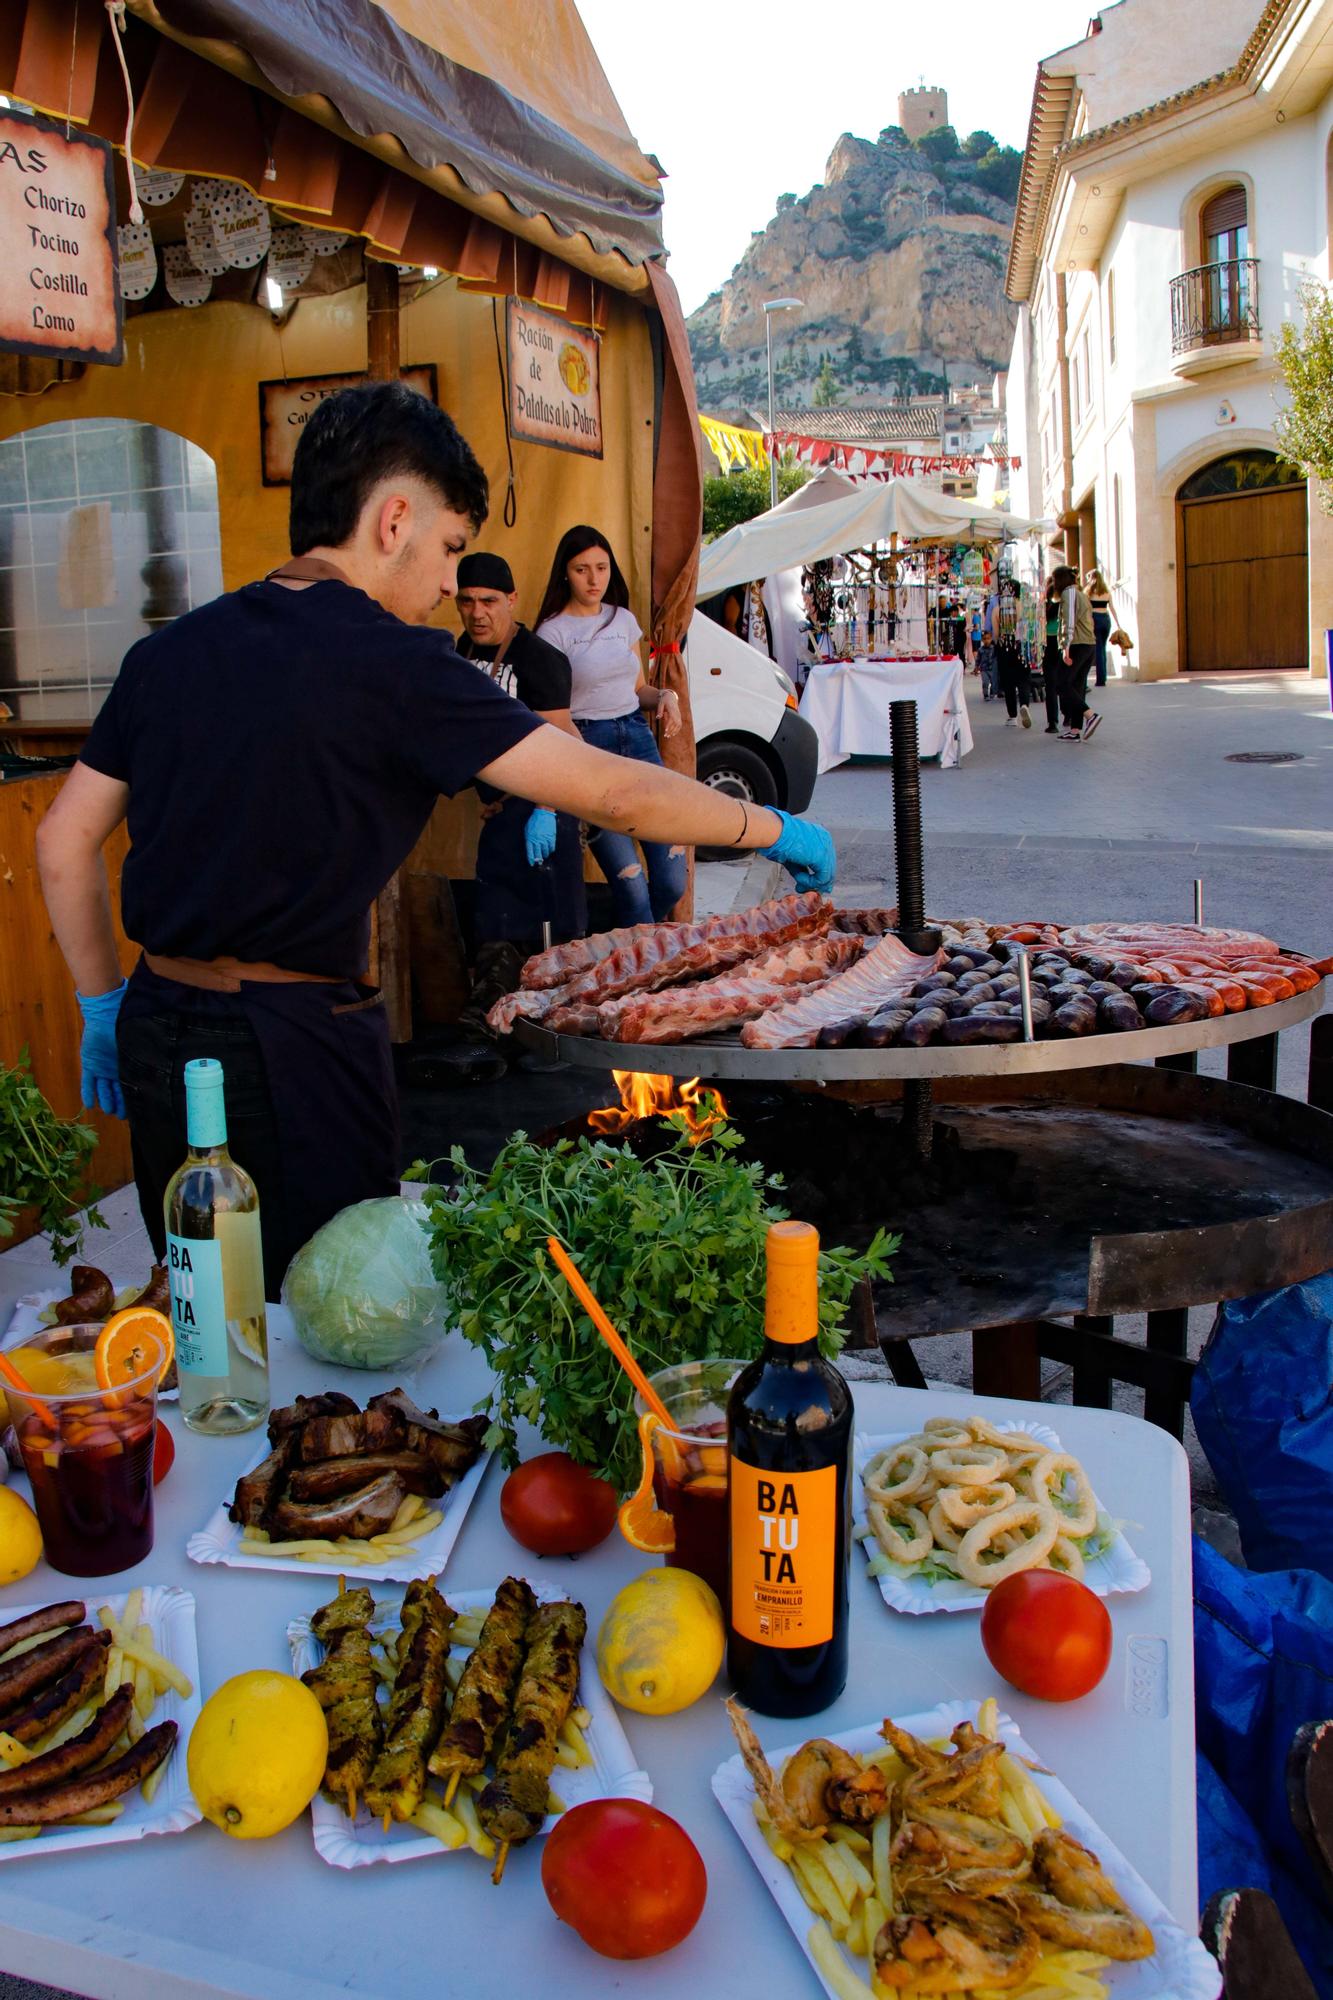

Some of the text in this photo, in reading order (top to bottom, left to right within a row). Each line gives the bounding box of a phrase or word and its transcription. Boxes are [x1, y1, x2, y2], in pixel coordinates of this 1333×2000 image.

[24, 186, 86, 219] Chorizo
[27, 224, 79, 256] Tocino
[30, 267, 88, 296] Costilla
[32, 305, 75, 332] Lomo
[516, 316, 553, 352] Ración
[530, 357, 542, 381] de
[516, 384, 597, 437] Patatas a lo Pobre
[170, 1243, 193, 1272] BA
[173, 1270, 195, 1299] TU
[175, 1296, 196, 1326] TA
[757, 1480, 799, 1515] BA
[759, 1515, 799, 1550] TU
[759, 1549, 796, 1584] TA
[755, 1591, 803, 1605] TEMPRANILLO
